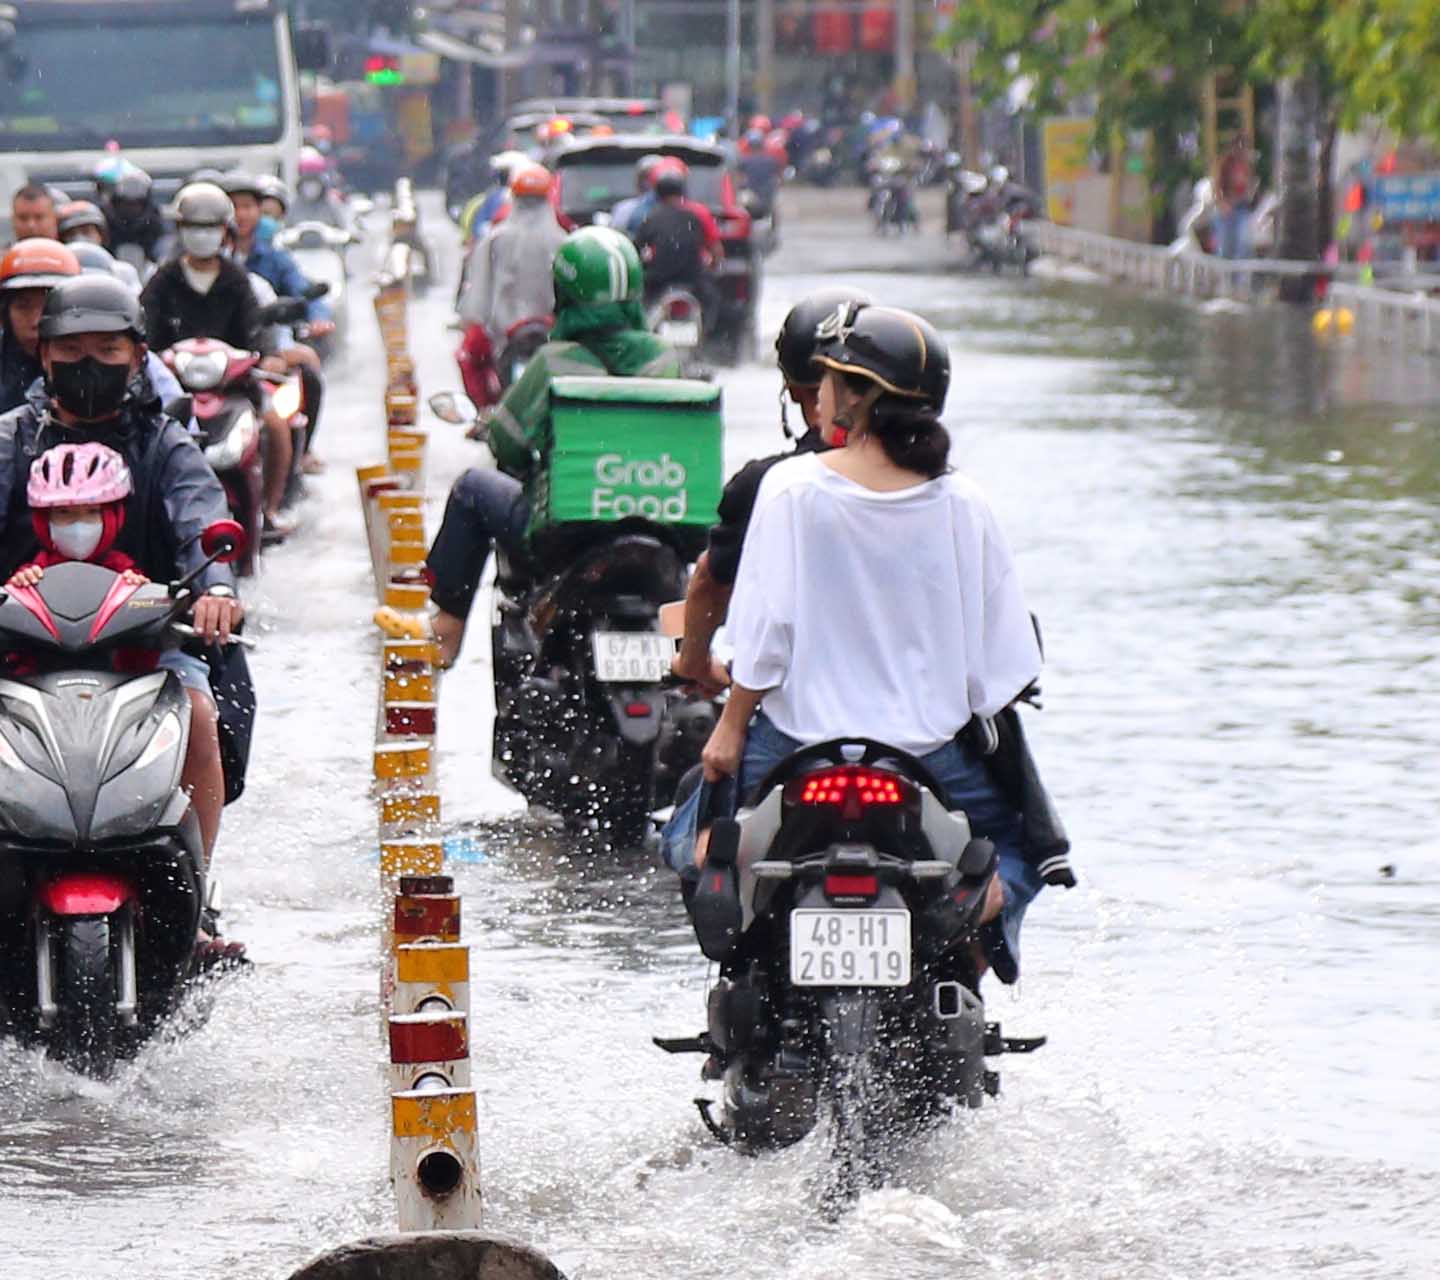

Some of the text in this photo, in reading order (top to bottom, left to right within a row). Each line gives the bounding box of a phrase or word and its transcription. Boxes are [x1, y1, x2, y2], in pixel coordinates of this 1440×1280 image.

[594, 452, 688, 489] Grab
[591, 487, 688, 521] Food
[810, 915, 890, 947] 48-H1
[799, 950, 903, 982] 269.19
